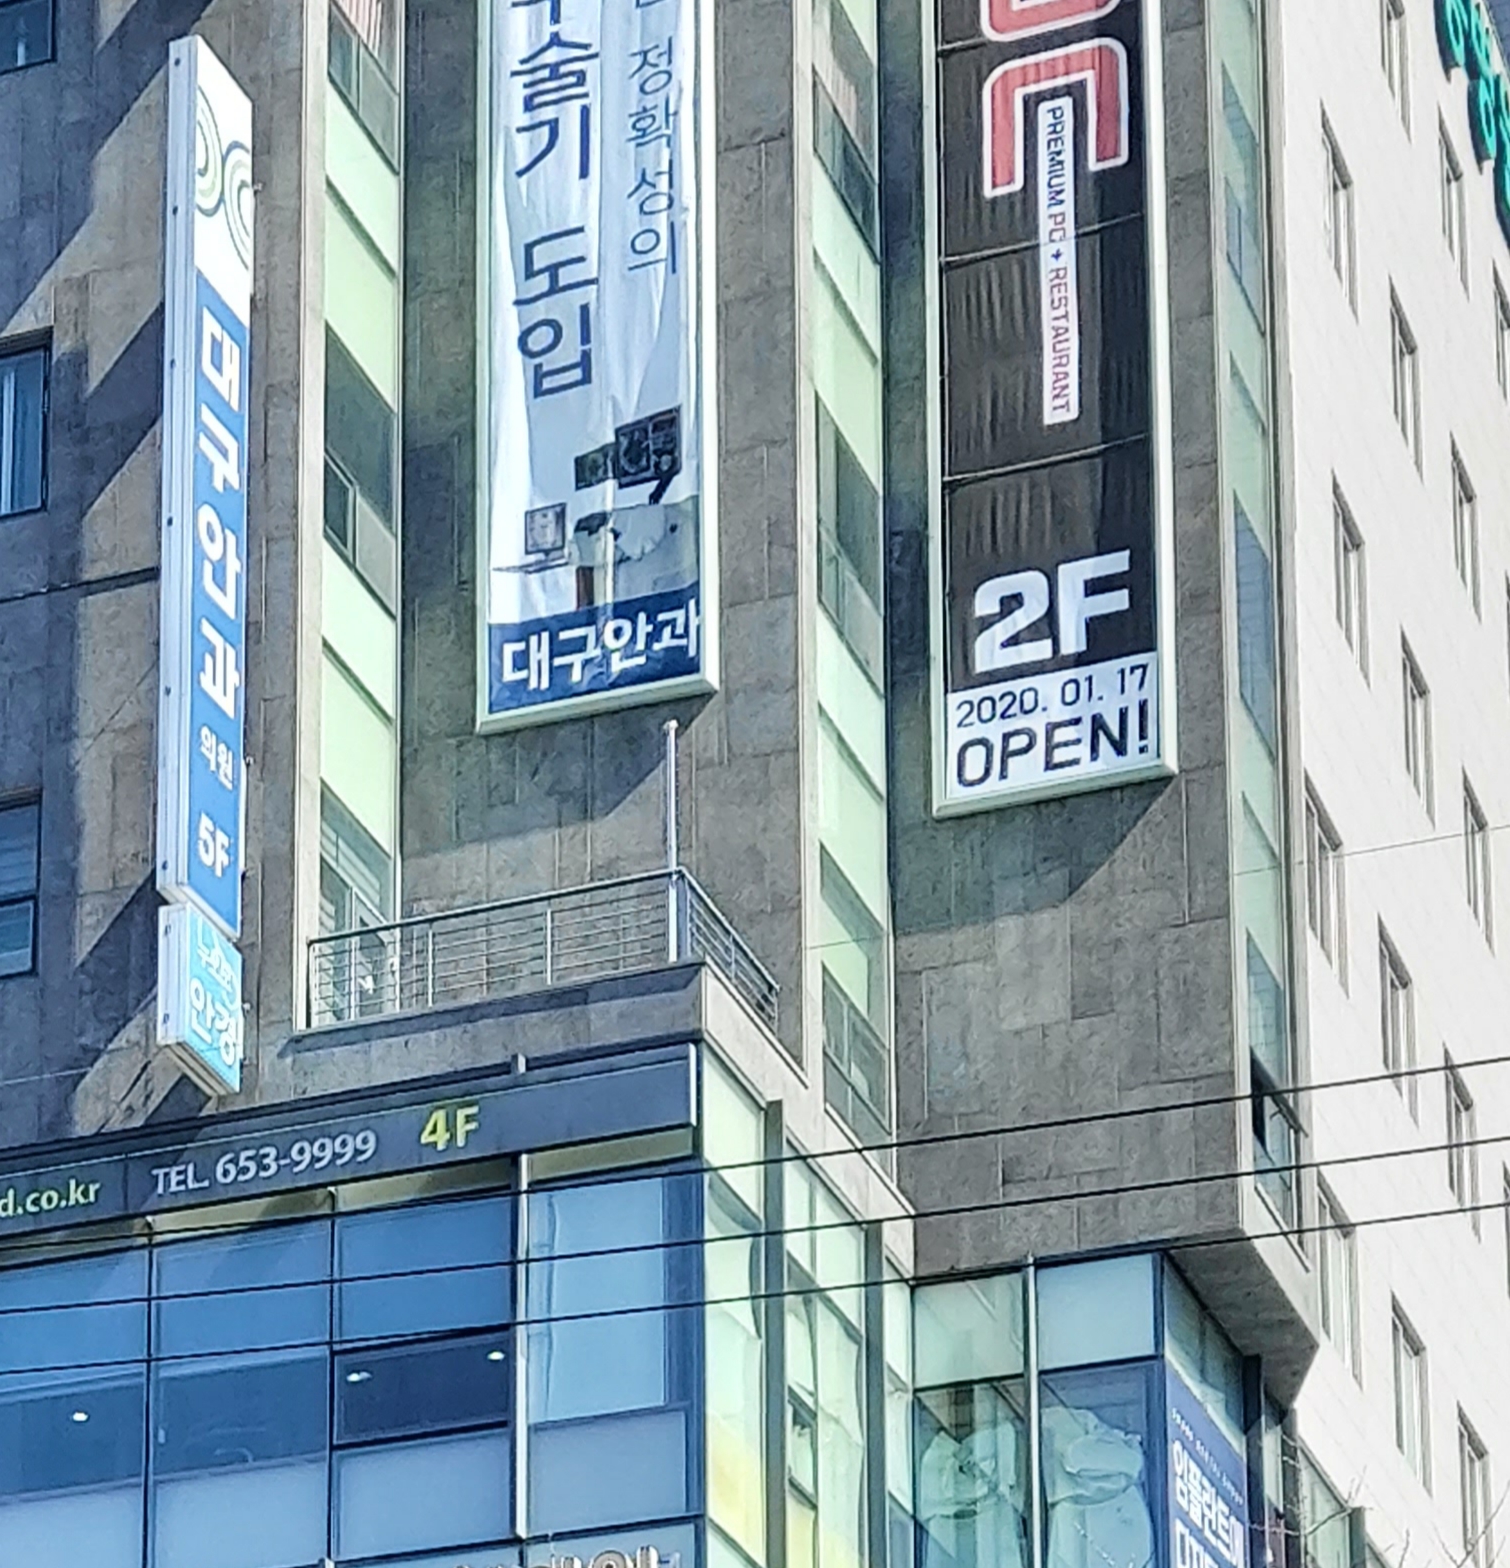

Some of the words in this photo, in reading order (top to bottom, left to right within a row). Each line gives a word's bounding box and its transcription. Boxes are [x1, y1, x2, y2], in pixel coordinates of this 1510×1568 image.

[1045, 105, 1069, 209] PREMIUM
[512, 225, 600, 399] 도입
[1048, 267, 1073, 414] RESTAURANT
[197, 305, 242, 720] 대구안과
[501, 598, 700, 690] 대구안과
[974, 549, 1131, 674] 2F
[1116, 665, 1150, 697] 17
[198, 724, 236, 790] 의원
[955, 697, 1150, 790] OPEN!
[196, 810, 230, 878] 5F
[215, 1129, 378, 1186] 653-9999
[419, 1102, 480, 1153] 4F
